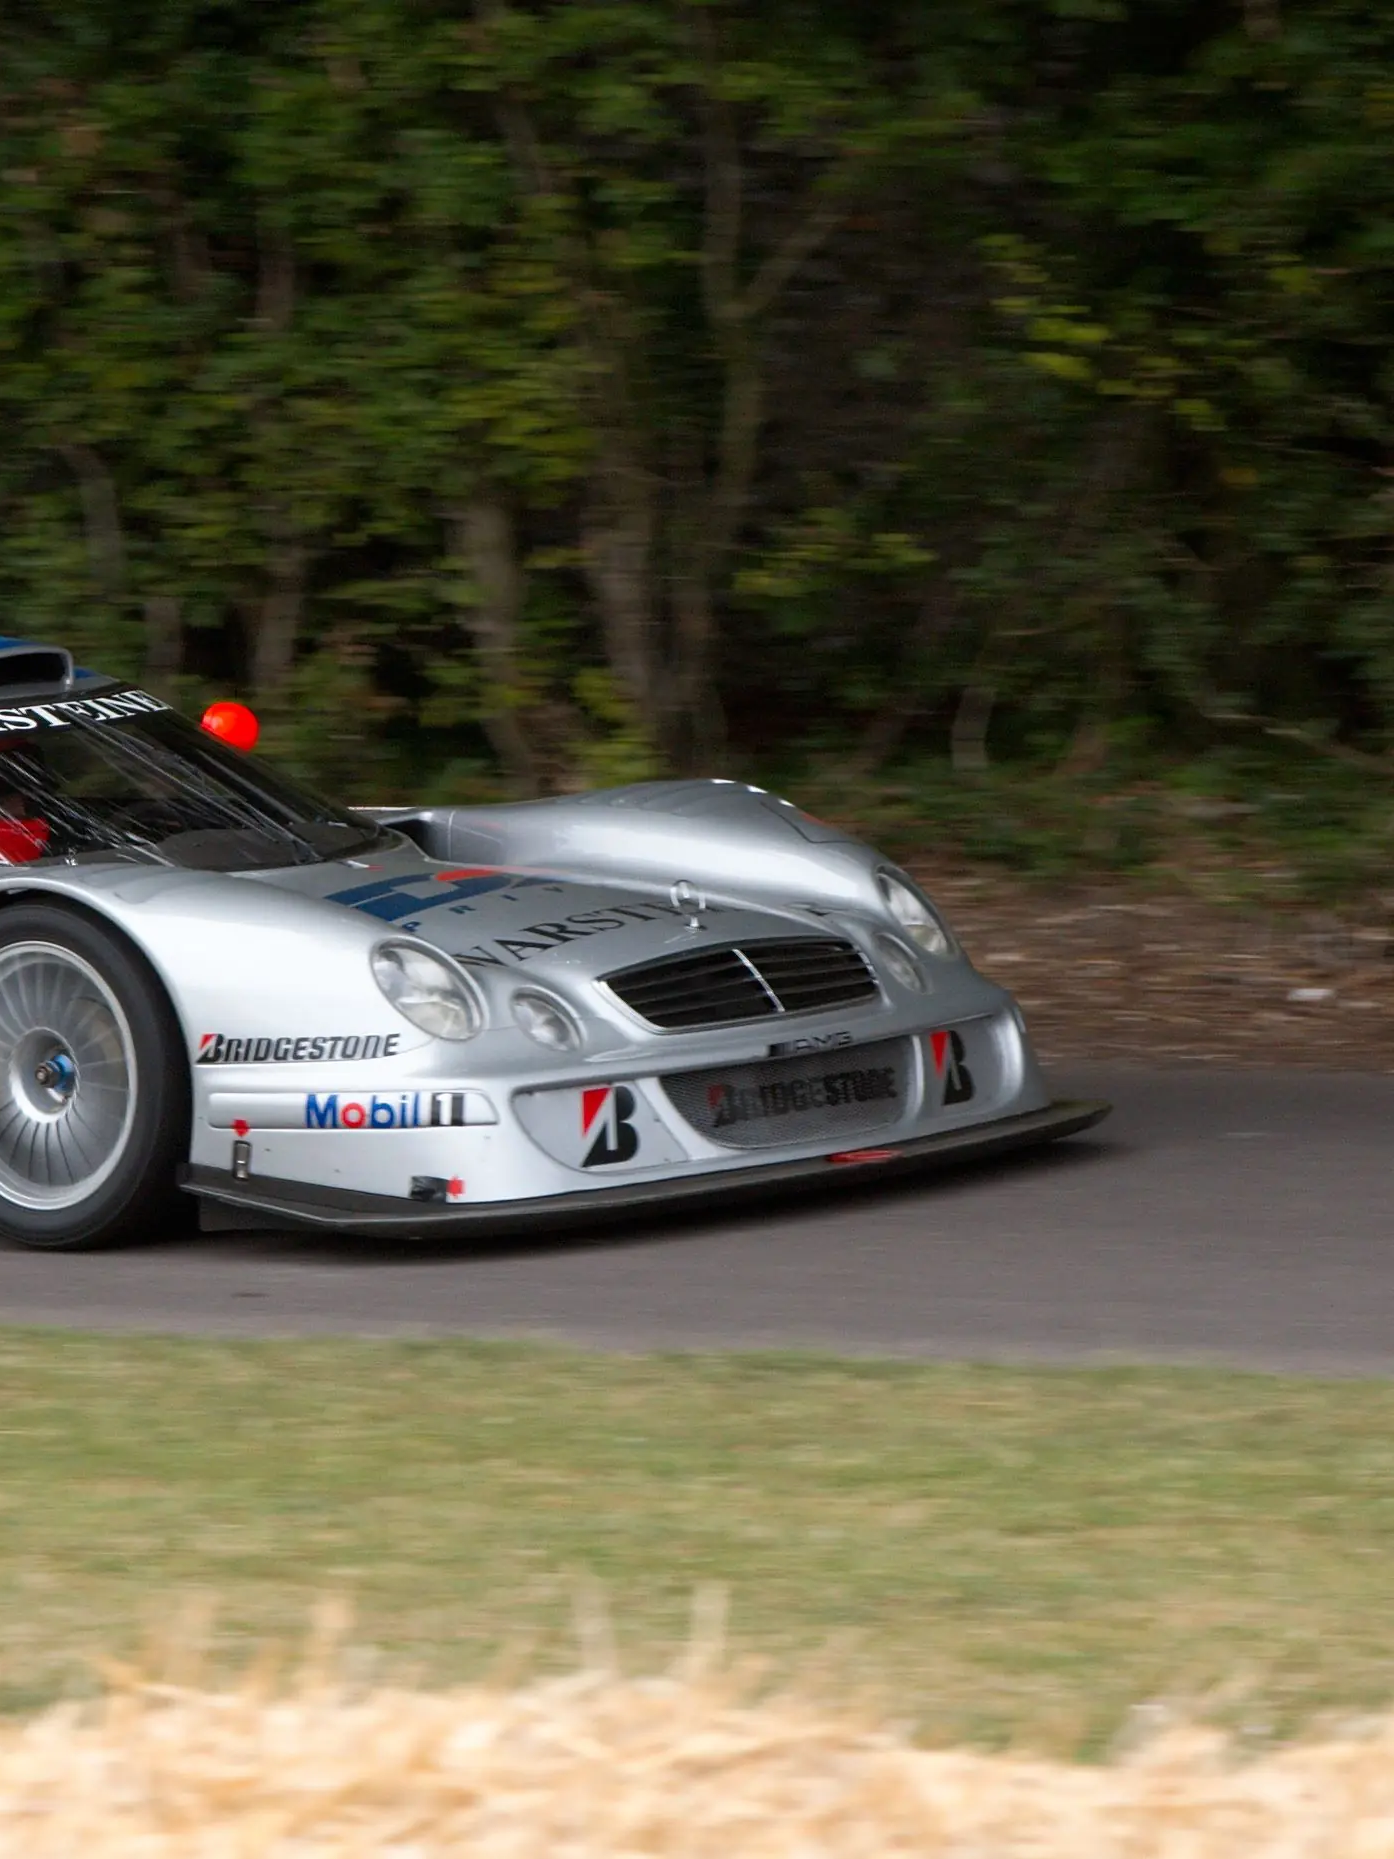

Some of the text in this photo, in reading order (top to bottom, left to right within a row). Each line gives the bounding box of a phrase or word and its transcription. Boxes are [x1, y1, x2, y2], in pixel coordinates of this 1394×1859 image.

[196, 1033, 401, 1064] BRIDGESTONE
[306, 1091, 463, 1129] Mobil 1
